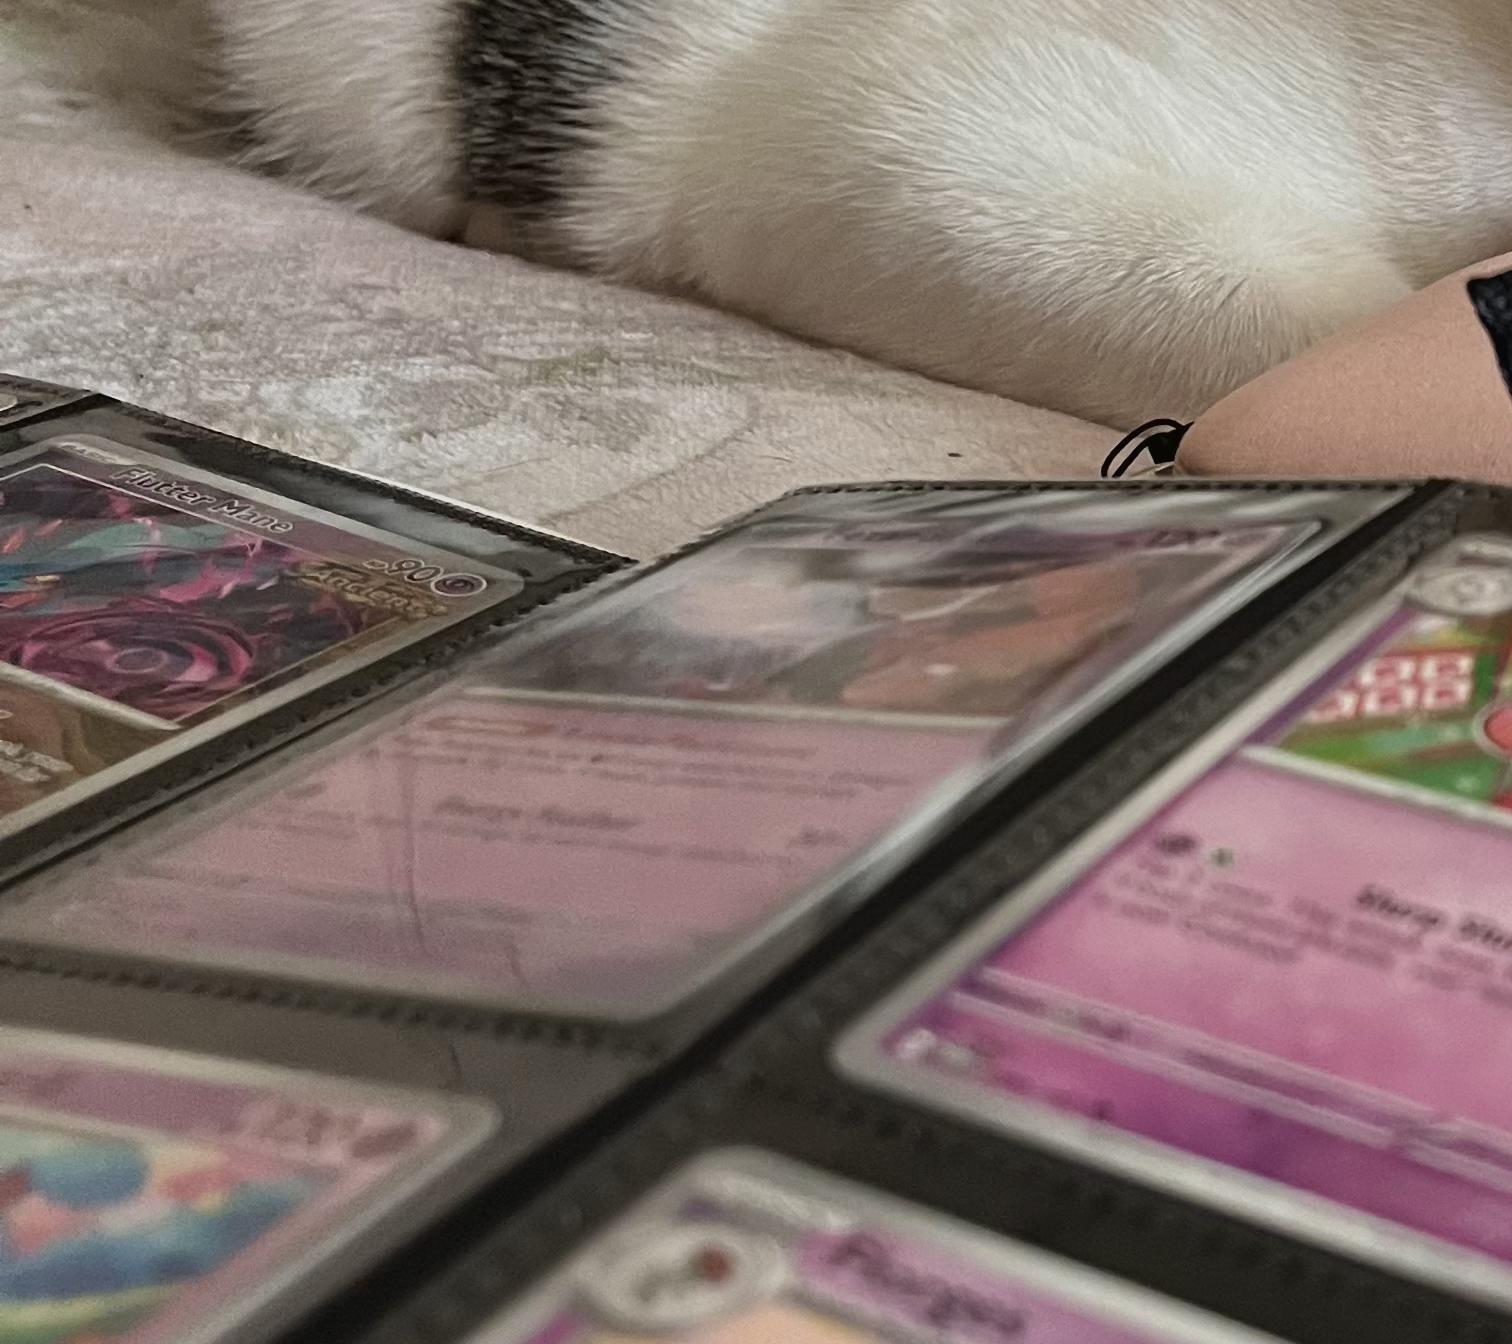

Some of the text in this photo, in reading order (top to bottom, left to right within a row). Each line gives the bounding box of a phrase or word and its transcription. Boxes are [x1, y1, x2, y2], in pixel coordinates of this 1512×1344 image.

[110, 465, 296, 536] Flutter Mane
[385, 558, 444, 583] 90
